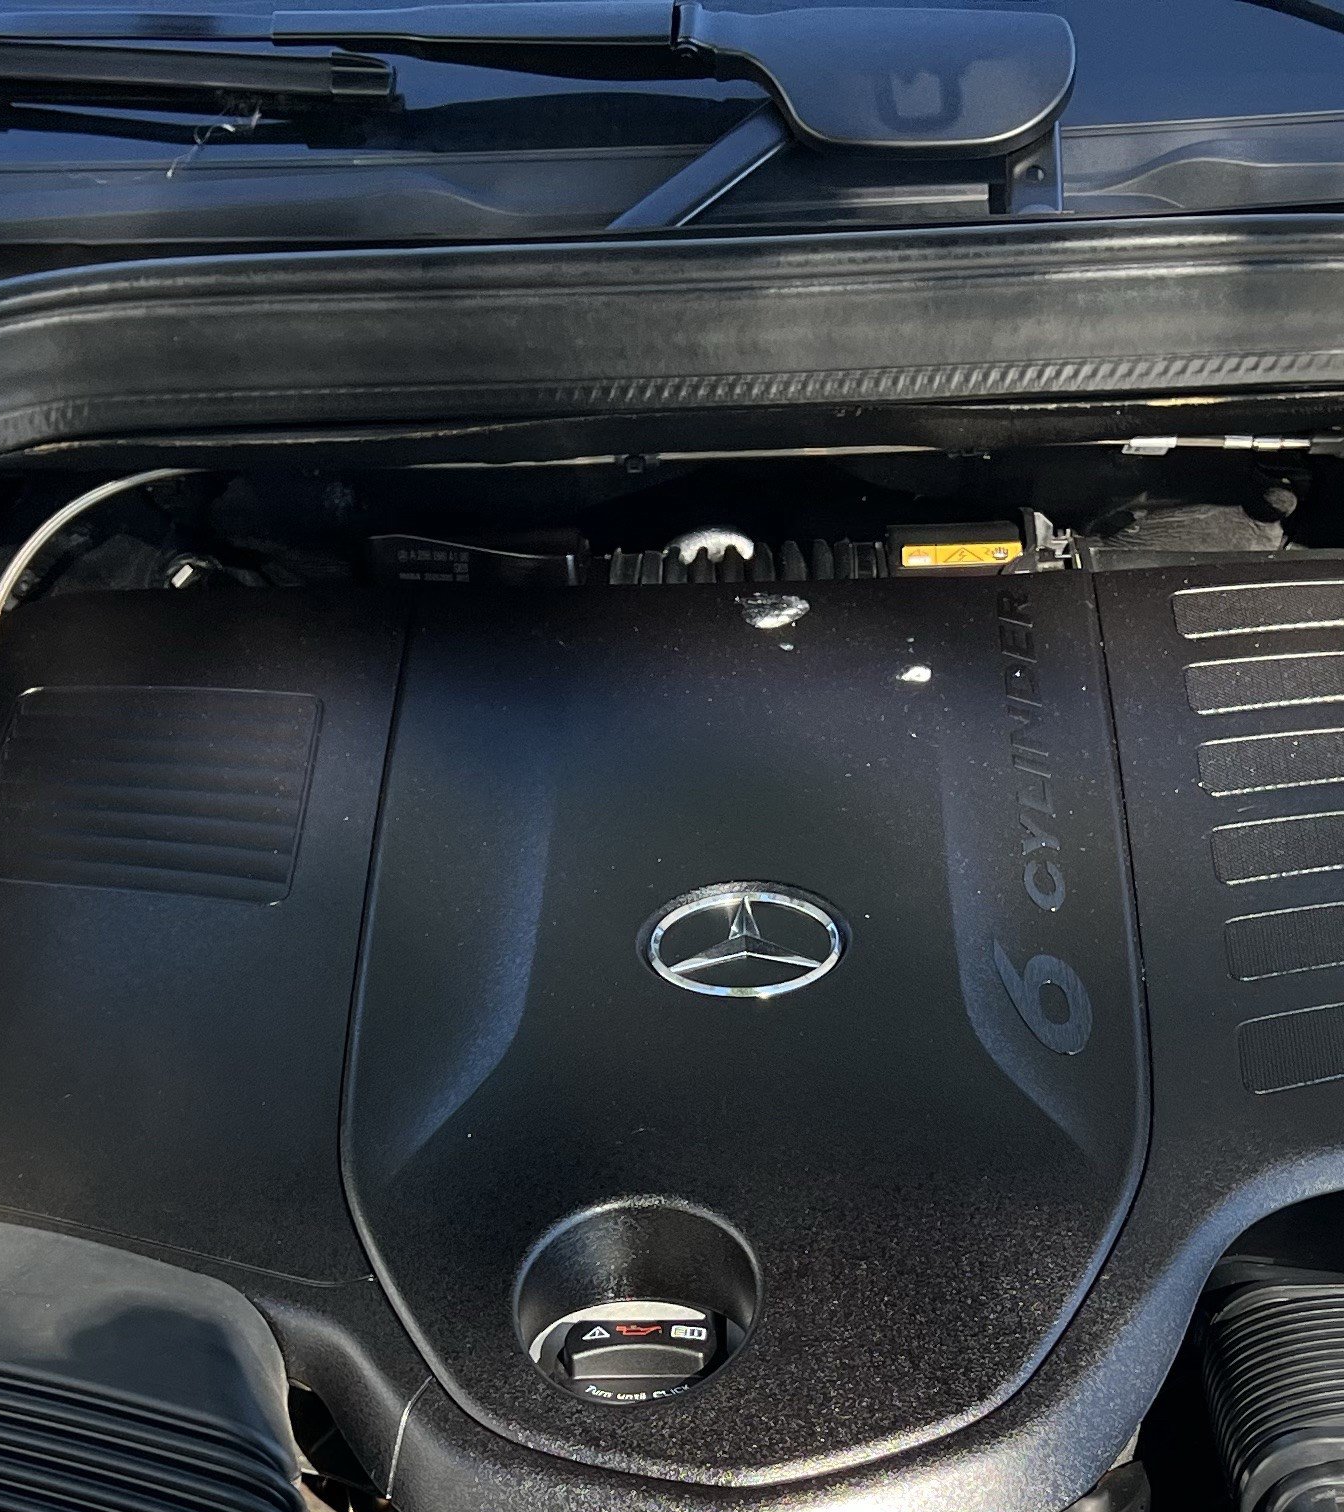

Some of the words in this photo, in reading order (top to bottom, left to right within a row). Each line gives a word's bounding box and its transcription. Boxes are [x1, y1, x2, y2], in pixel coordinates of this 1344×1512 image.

[997, 589, 1066, 911] CYLINDER
[993, 938, 1093, 1056] 6
[584, 1384, 614, 1399] Turn
[616, 1391, 647, 1401] until
[652, 1383, 690, 1399] CLICK
